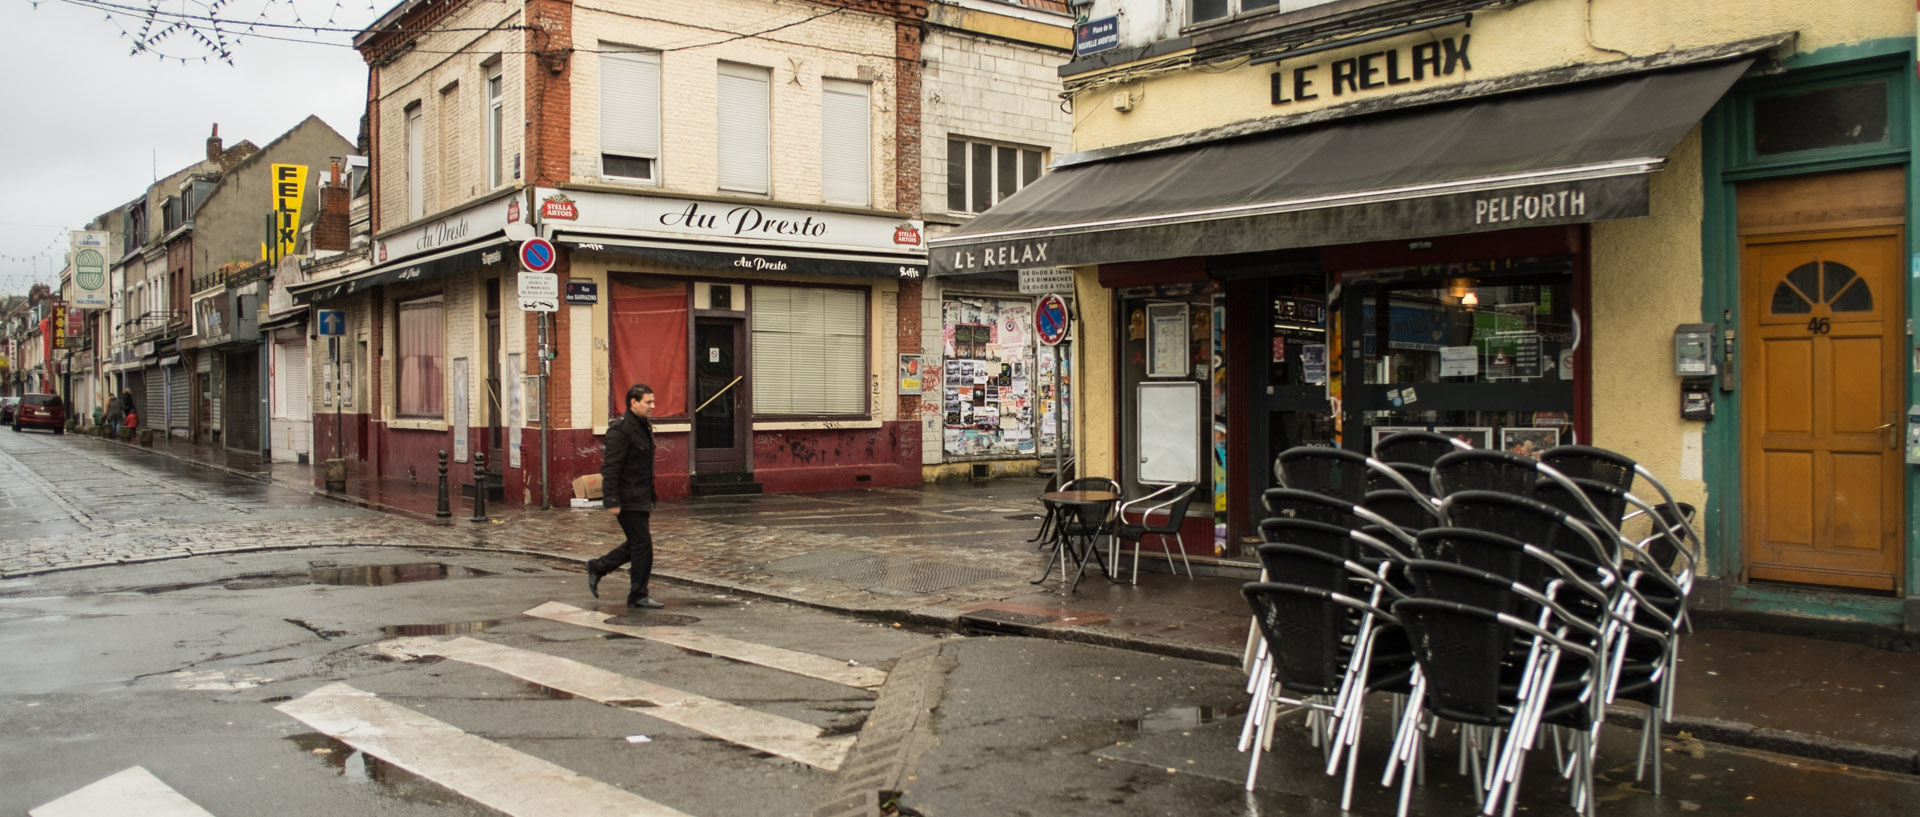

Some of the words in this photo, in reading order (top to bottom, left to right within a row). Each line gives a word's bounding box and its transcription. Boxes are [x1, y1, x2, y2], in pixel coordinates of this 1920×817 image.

[1078, 38, 1097, 50] NOUVELLE
[1098, 34, 1117, 46] AVENTURE
[1092, 26, 1102, 34] Place
[1271, 64, 1318, 106] LE
[1332, 34, 1472, 96] RELAX
[278, 166, 298, 243] FELIX
[1476, 190, 1585, 224] PELFORTH
[659, 202, 719, 229] Au
[726, 206, 828, 237] Presto
[416, 226, 432, 250] Au
[436, 218, 469, 246] Presto
[734, 256, 752, 268] Au
[754, 257, 787, 270] Presto
[954, 252, 975, 269] LE
[984, 242, 1048, 266] RELAX
[900, 266, 919, 278] Leffe
[1808, 316, 1830, 334] 46
